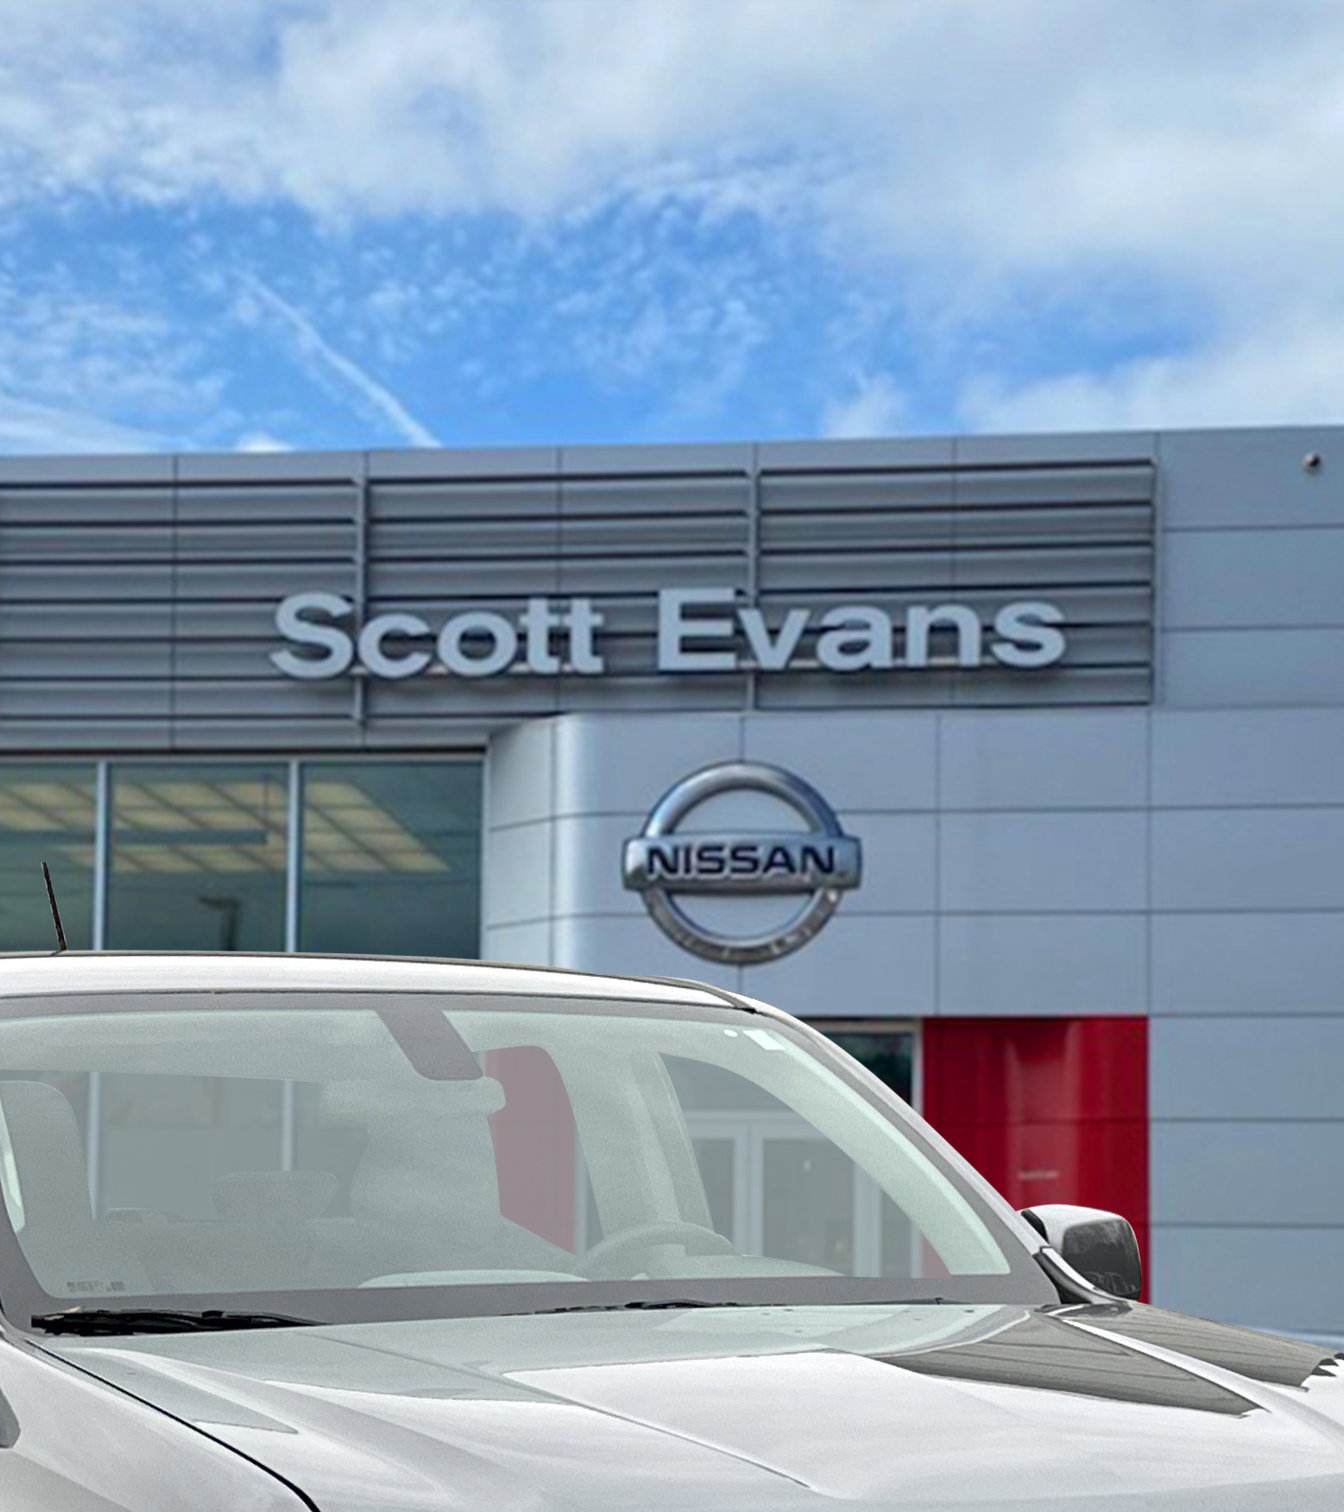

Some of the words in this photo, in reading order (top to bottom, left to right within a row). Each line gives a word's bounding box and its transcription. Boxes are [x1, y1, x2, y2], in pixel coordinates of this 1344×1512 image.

[269, 589, 606, 680] Scott
[656, 586, 1069, 673] Evans
[645, 844, 836, 876] NISSAN
